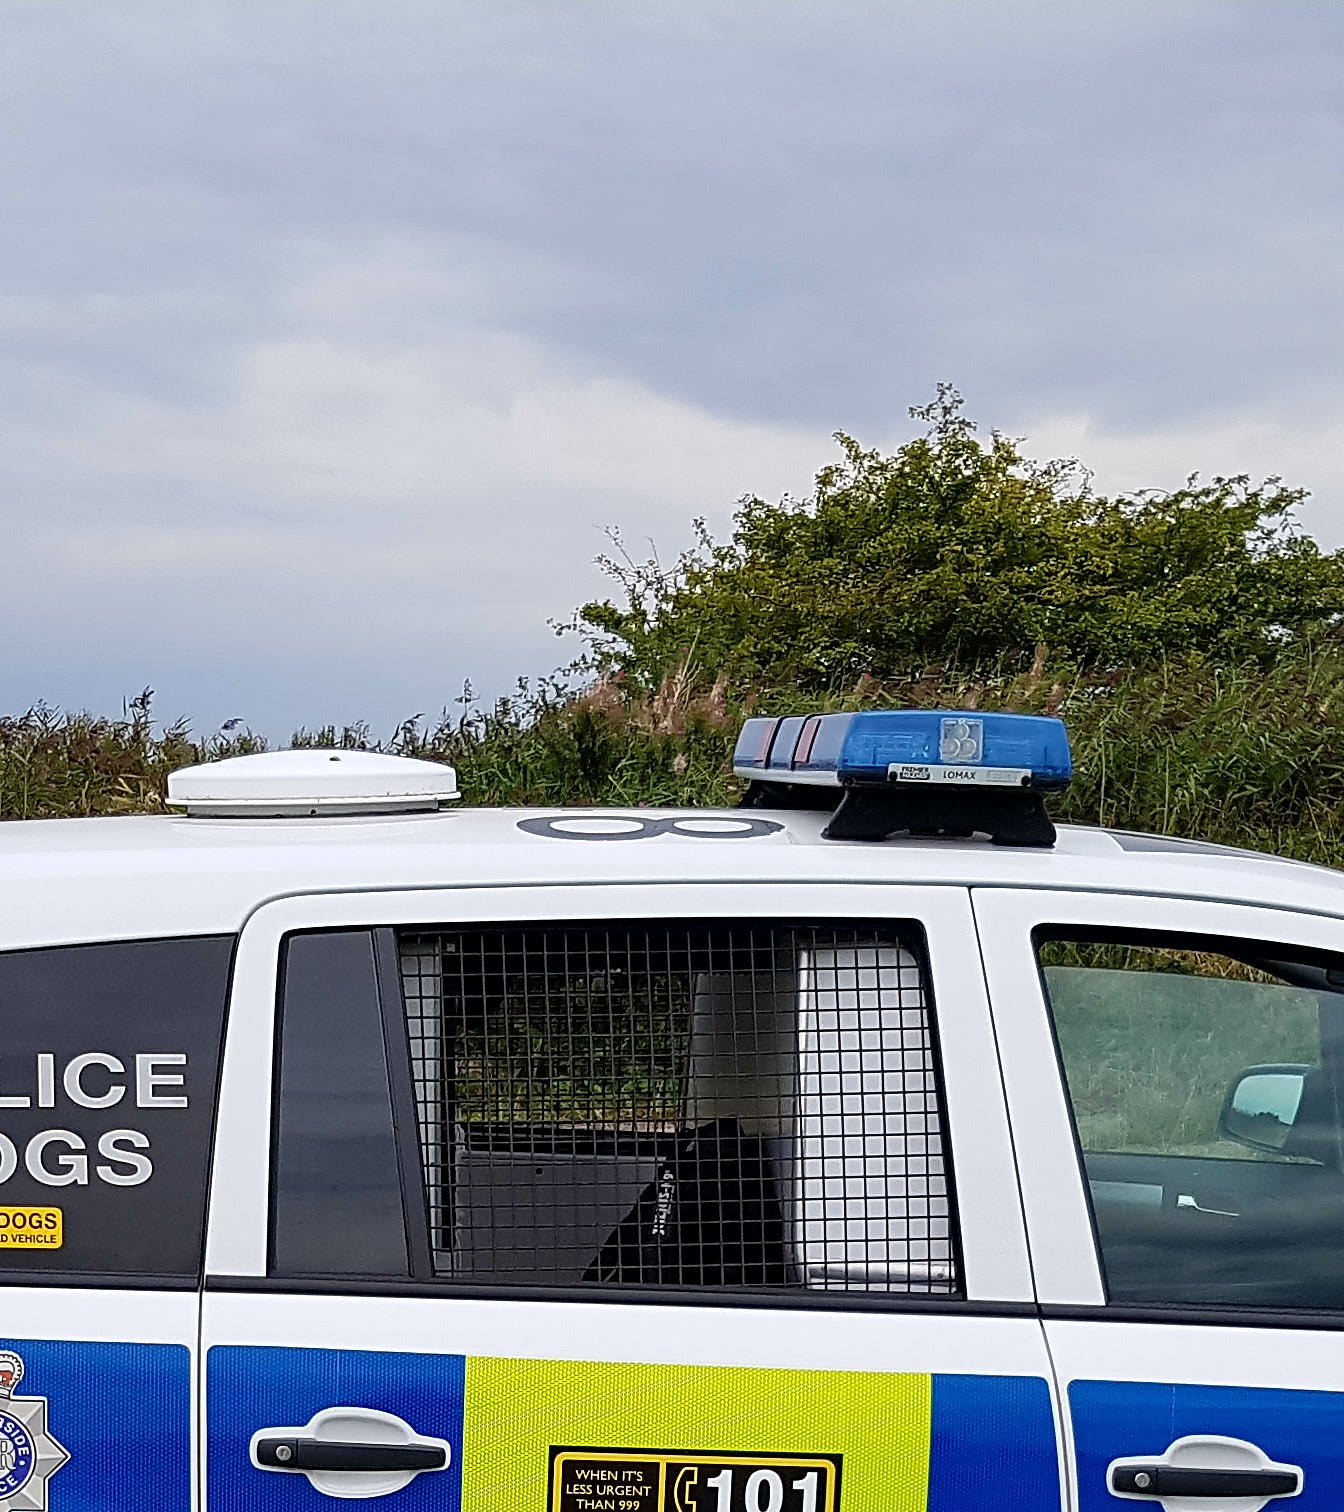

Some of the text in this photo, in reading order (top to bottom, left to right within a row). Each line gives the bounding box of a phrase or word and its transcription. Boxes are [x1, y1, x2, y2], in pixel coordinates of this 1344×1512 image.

[943, 770, 976, 780] LOMAX
[11, 1234, 57, 1244] VEHICLE
[575, 1469, 644, 1482] WHEN IT'S
[566, 1483, 652, 1497] LESS URGENT
[576, 1498, 640, 1511] THAN 999
